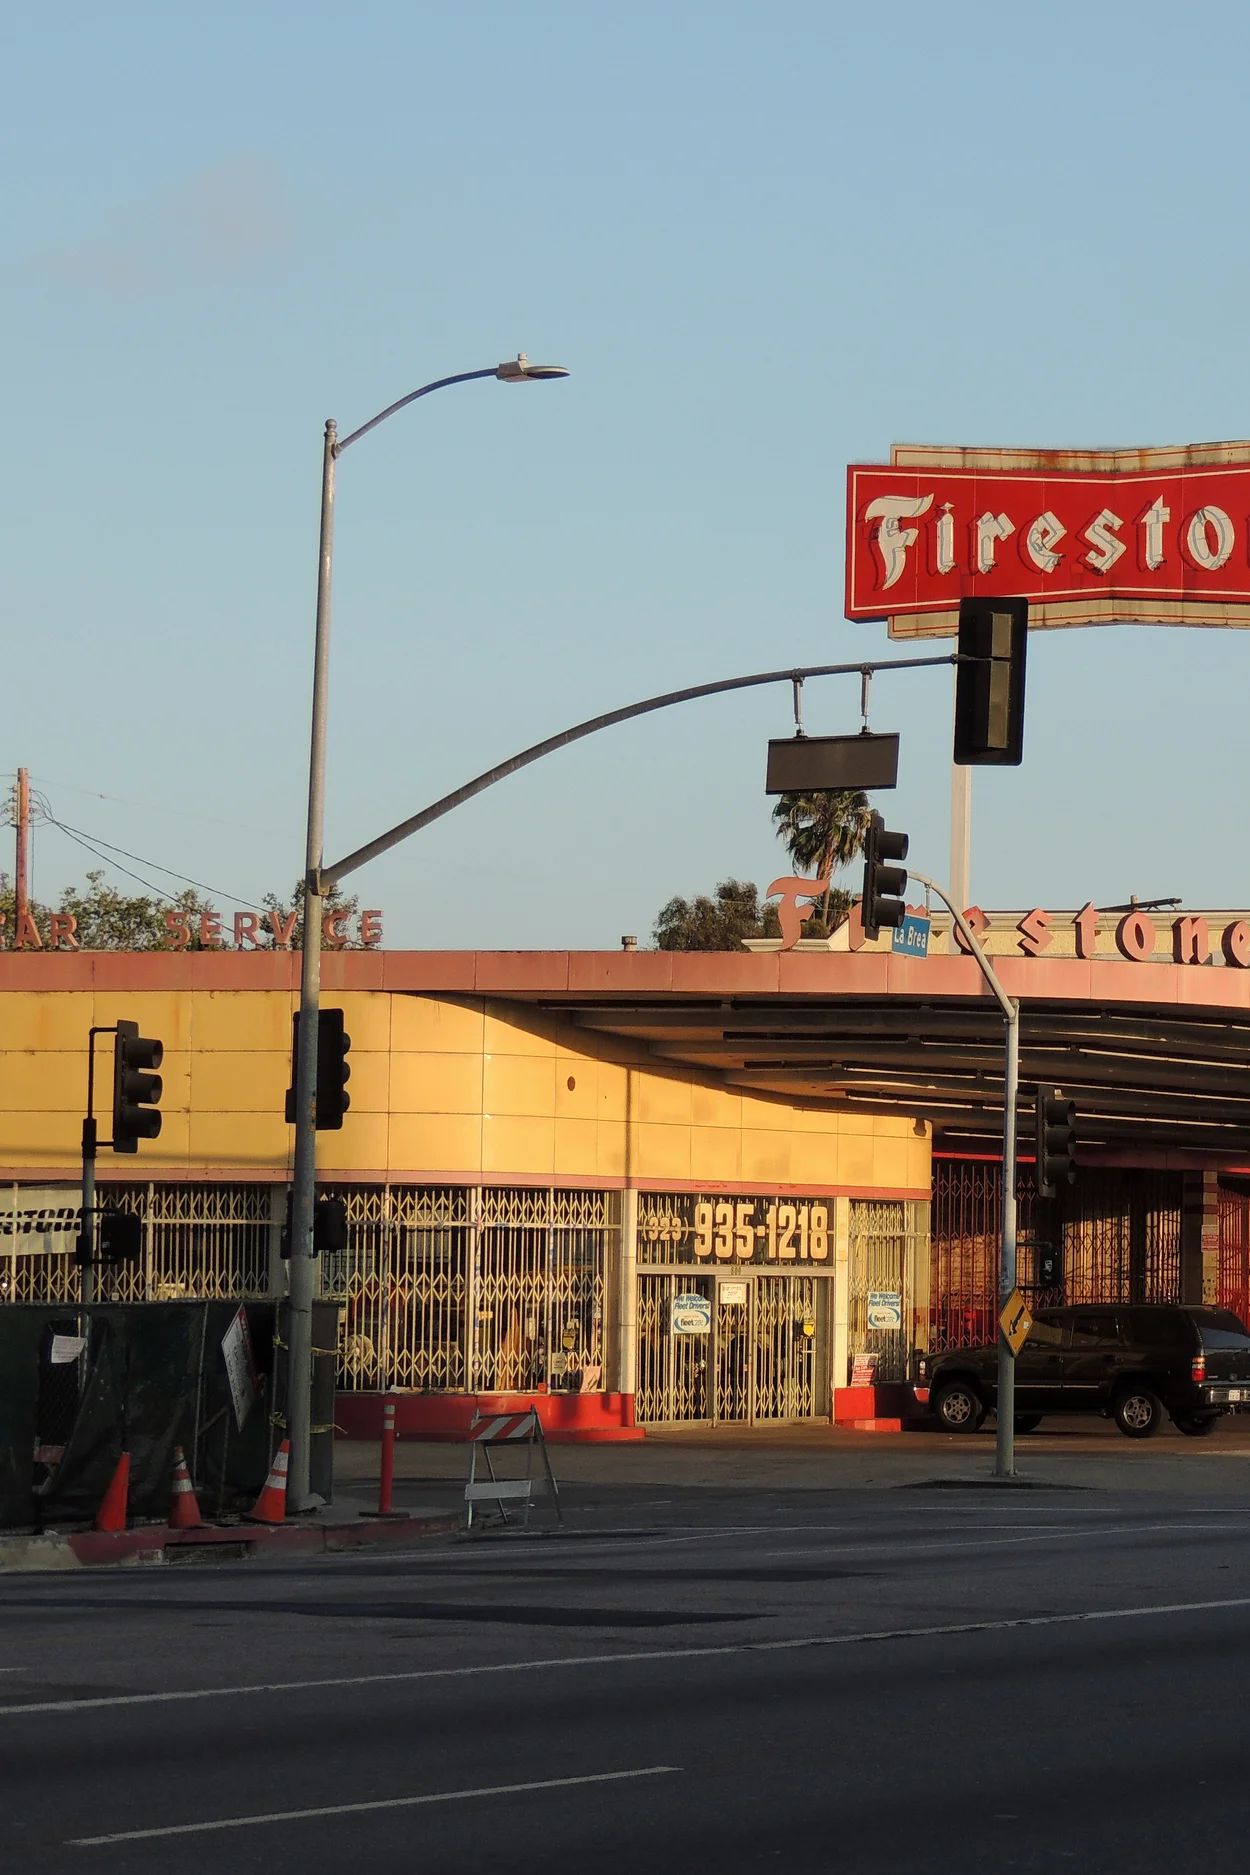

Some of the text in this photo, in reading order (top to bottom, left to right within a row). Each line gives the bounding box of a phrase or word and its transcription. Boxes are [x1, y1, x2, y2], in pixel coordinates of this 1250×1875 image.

[0, 909, 383, 949] AR SERVCE
[895, 926, 926, 948] La Brea
[642, 1203, 827, 1259] (323) 935-1218
[674, 1302, 688, 1310] Fleet
[868, 1299, 881, 1307] Fleet
